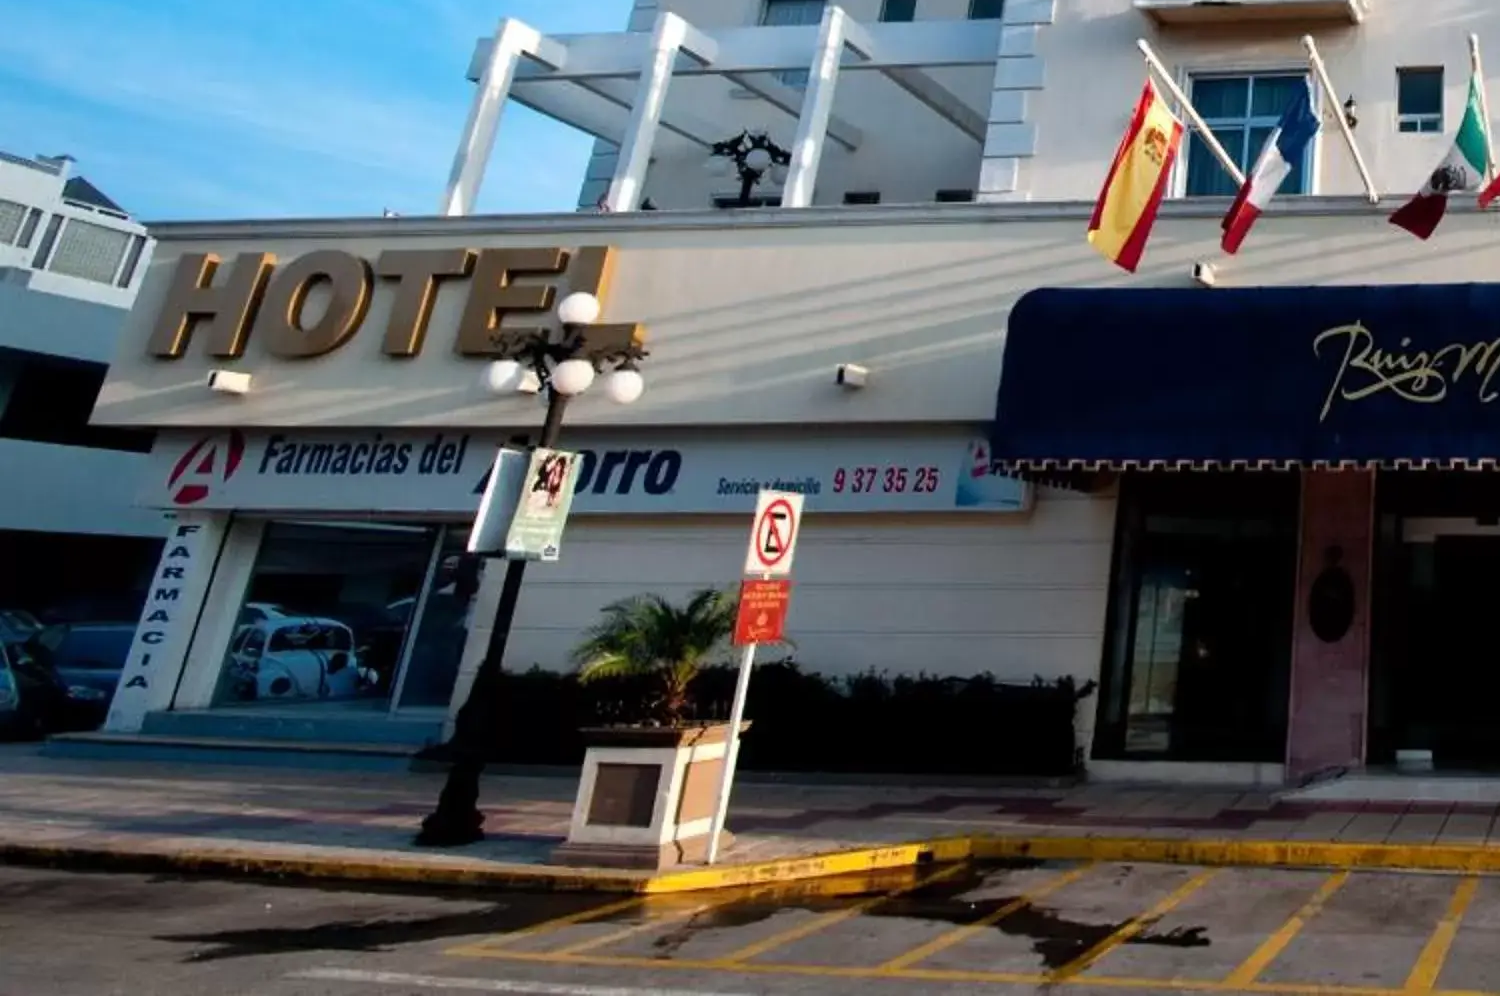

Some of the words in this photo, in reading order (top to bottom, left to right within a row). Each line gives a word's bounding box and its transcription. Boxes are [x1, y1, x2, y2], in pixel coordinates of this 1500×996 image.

[148, 245, 648, 358] HOTEL
[1313, 319, 1446, 422] Ruiz
[259, 434, 412, 475] Farmacias
[417, 434, 469, 475] del
[717, 477, 760, 495] Servicio
[832, 467, 846, 493] 9
[852, 467, 877, 493] 37
[883, 467, 908, 493] 35
[912, 467, 940, 493] 25
[124, 524, 202, 689] FARMACIA
